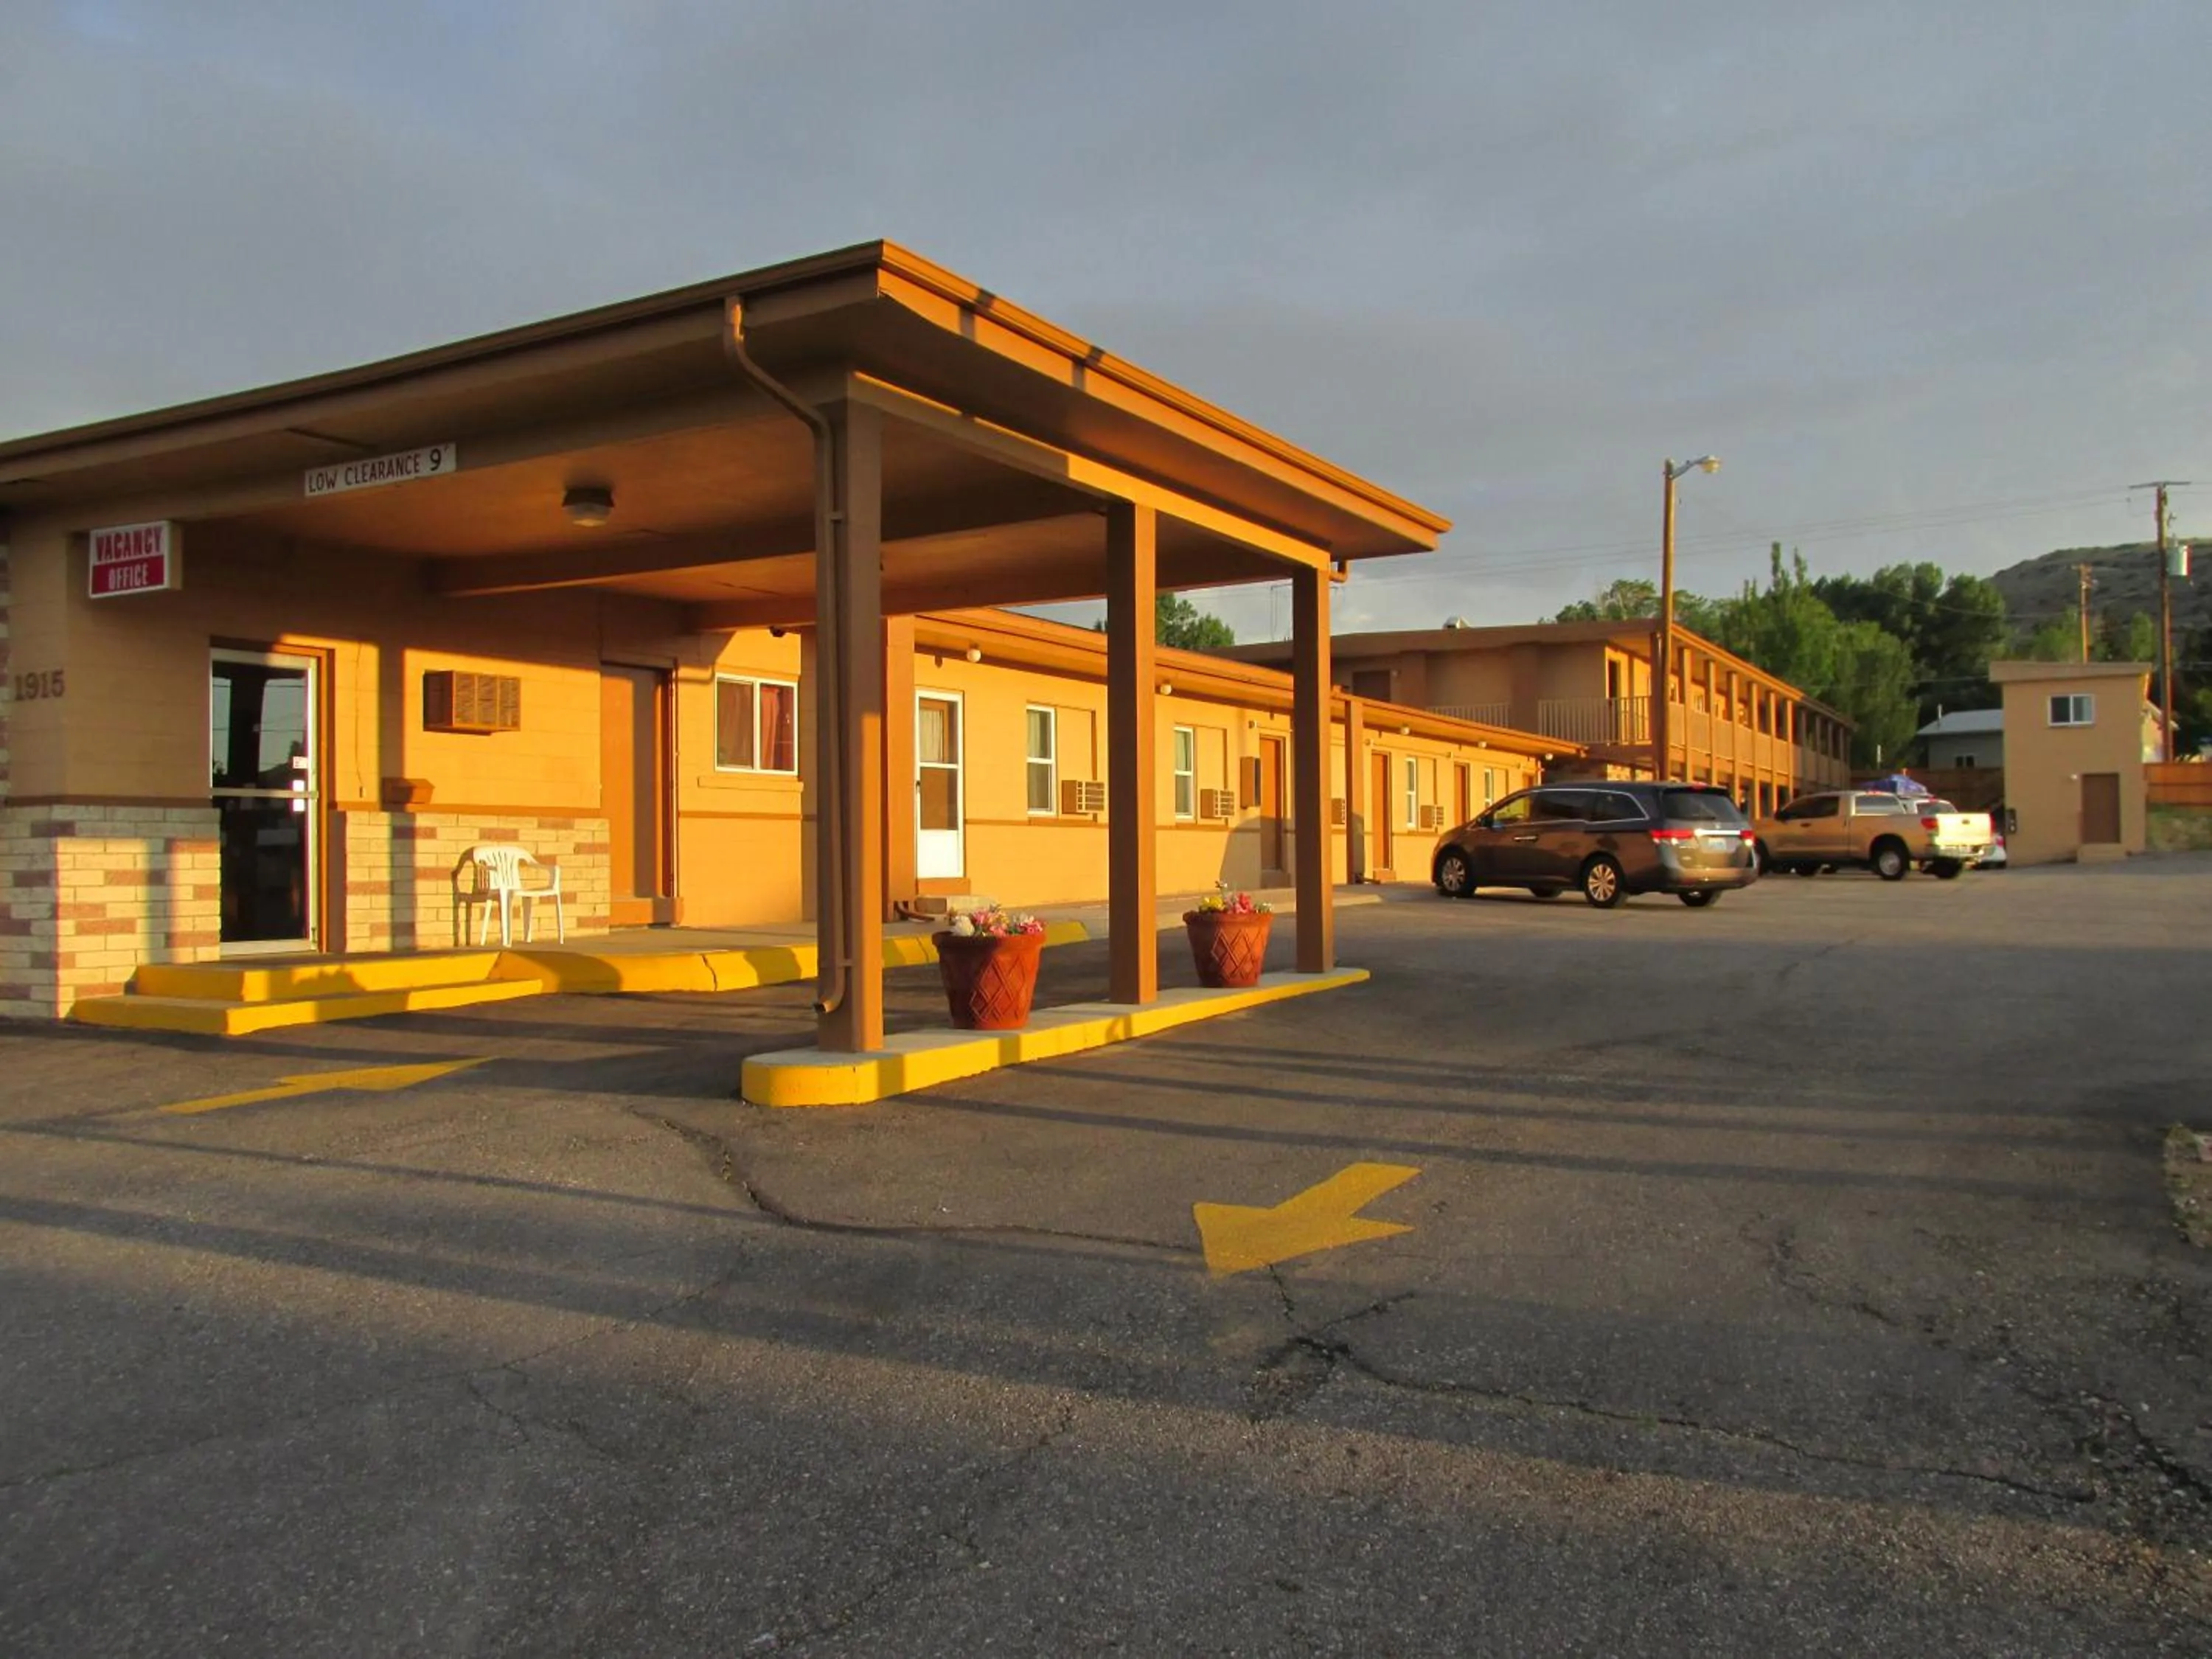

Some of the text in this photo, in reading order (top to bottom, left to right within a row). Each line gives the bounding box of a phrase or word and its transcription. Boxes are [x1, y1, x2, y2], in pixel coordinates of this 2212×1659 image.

[308, 469, 337, 493] LOW
[344, 453, 421, 486] CLEARANCE
[96, 526, 163, 562] VACANCY
[108, 563, 148, 590] OFFICE
[15, 669, 65, 702] 1915
